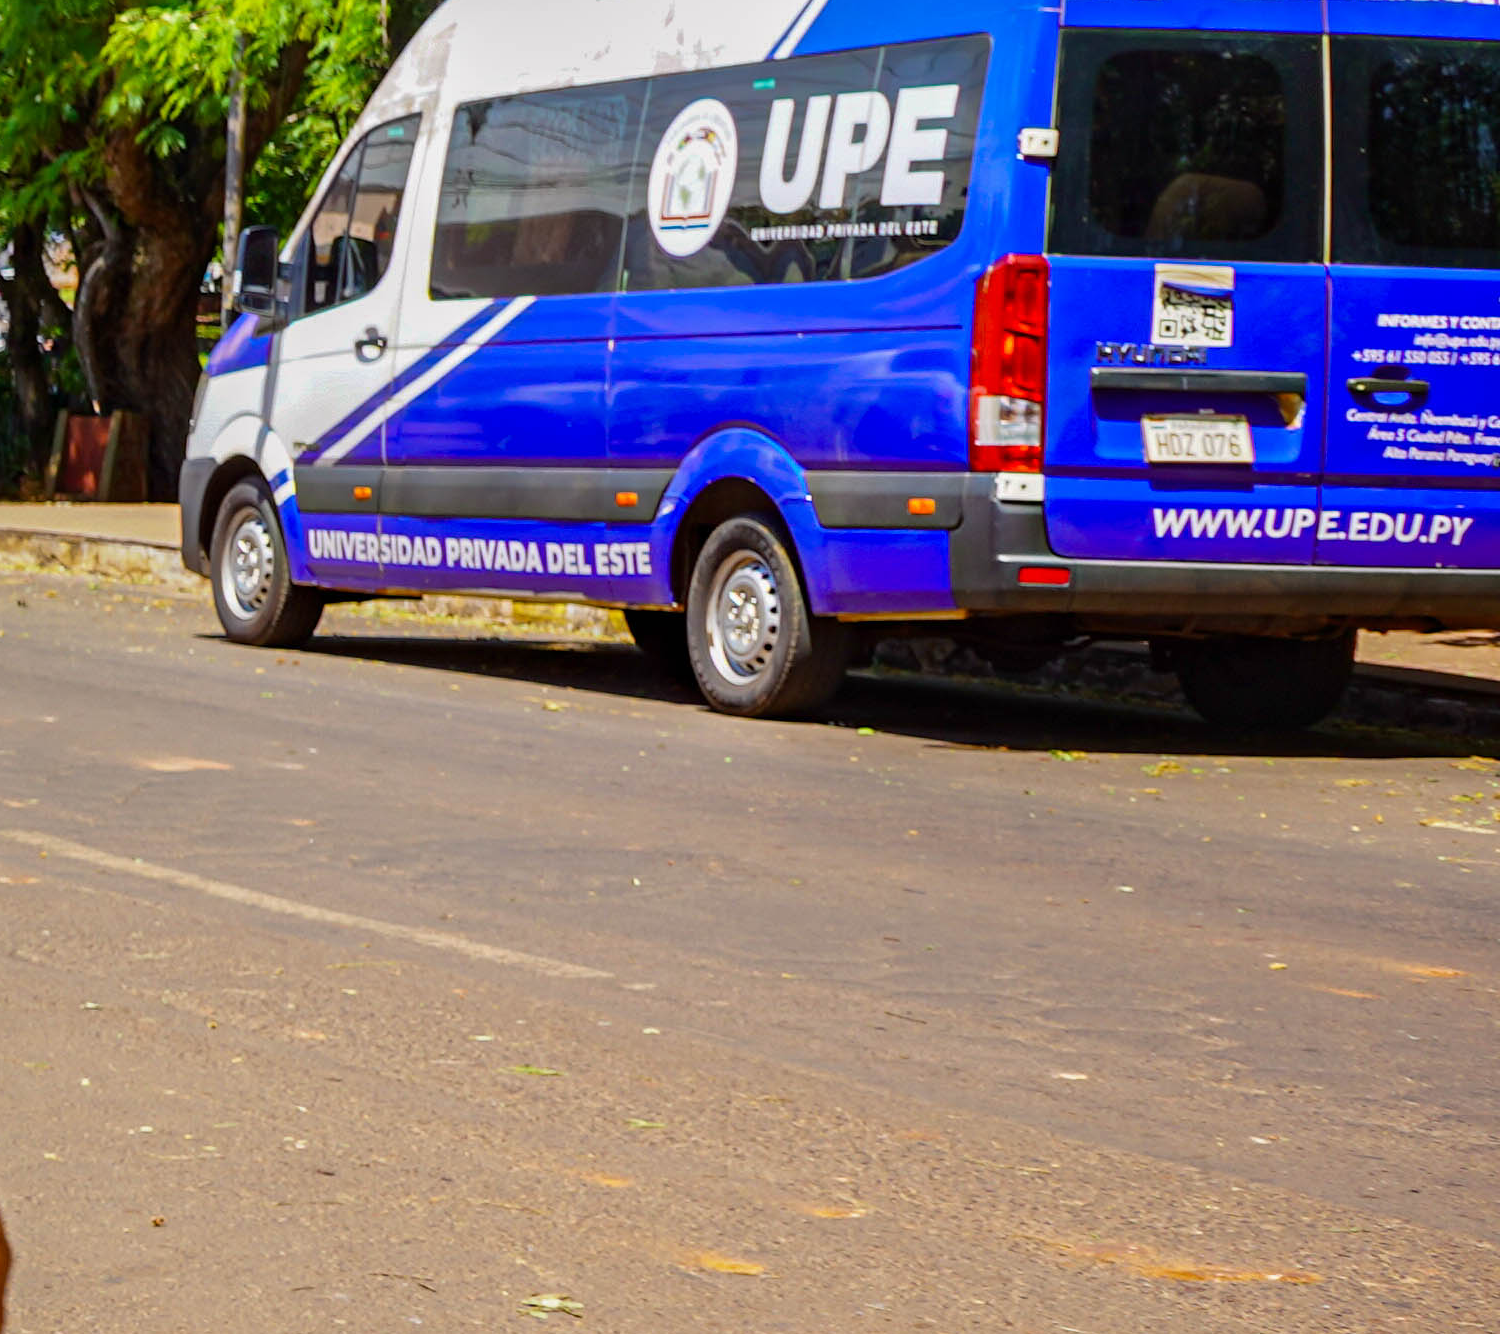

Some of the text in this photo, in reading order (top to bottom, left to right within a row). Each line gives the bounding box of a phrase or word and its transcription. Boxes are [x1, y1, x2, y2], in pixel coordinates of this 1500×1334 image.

[759, 84, 960, 214] UPE
[1156, 433, 1242, 457] HDZ 076
[1153, 508, 1473, 545] WWW.UPE.EDU.PY
[308, 529, 652, 576] UNIVERSIDAD PRIVADA DEL ESTE
